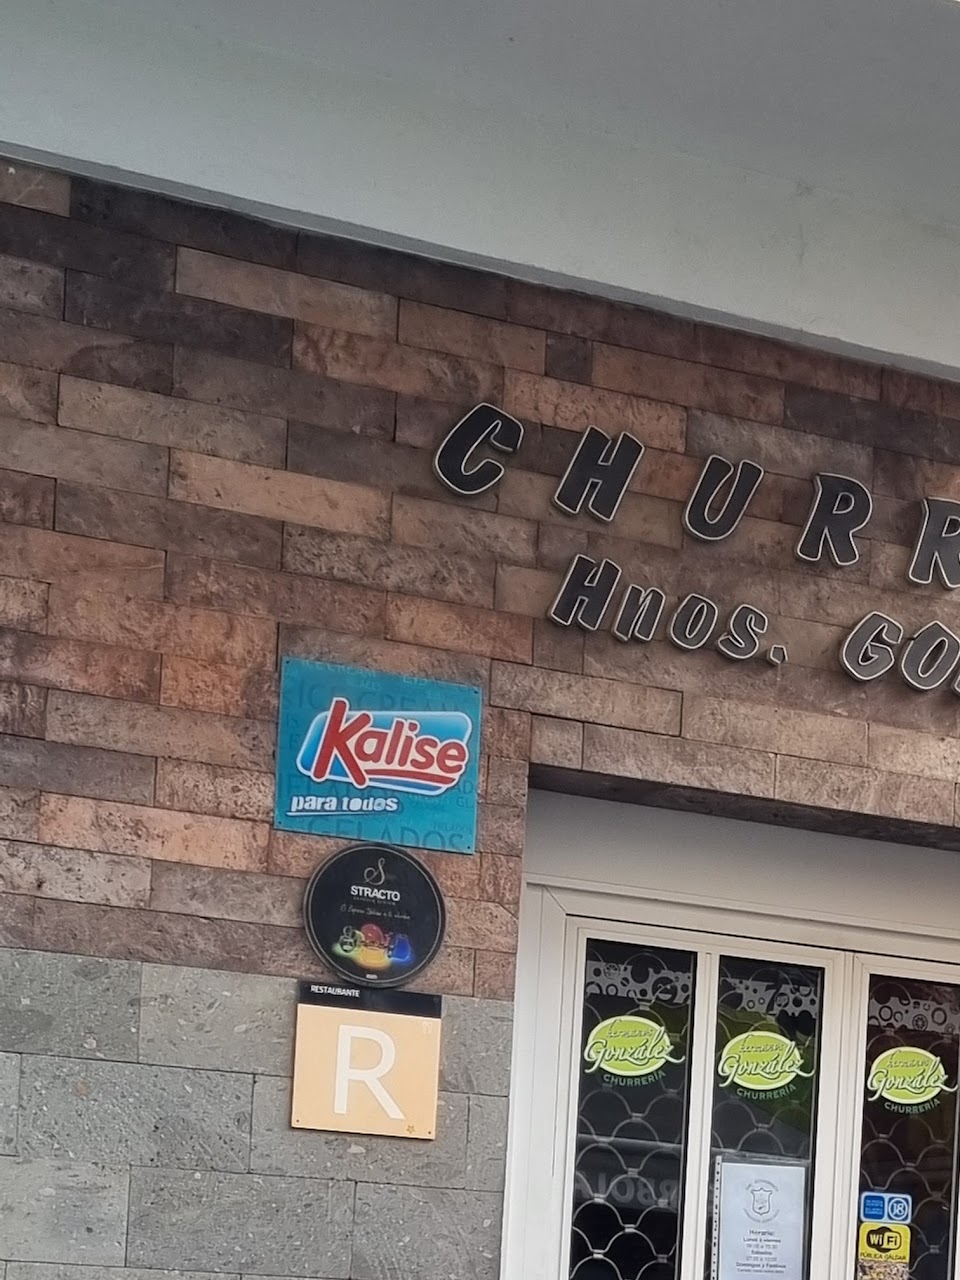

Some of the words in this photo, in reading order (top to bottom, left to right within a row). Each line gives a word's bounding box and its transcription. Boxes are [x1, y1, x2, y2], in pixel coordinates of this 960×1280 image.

[550, 554, 788, 665] Hnos.
[312, 699, 468, 787] Kalise
[291, 796, 337, 812] para
[342, 797, 399, 812] todos
[350, 885, 400, 902] STRACTO
[310, 984, 360, 998] RESTAURANTE
[333, 1024, 406, 1120] R
[893, 1203, 905, 1216] 18
[869, 1233, 898, 1247] WiFi
